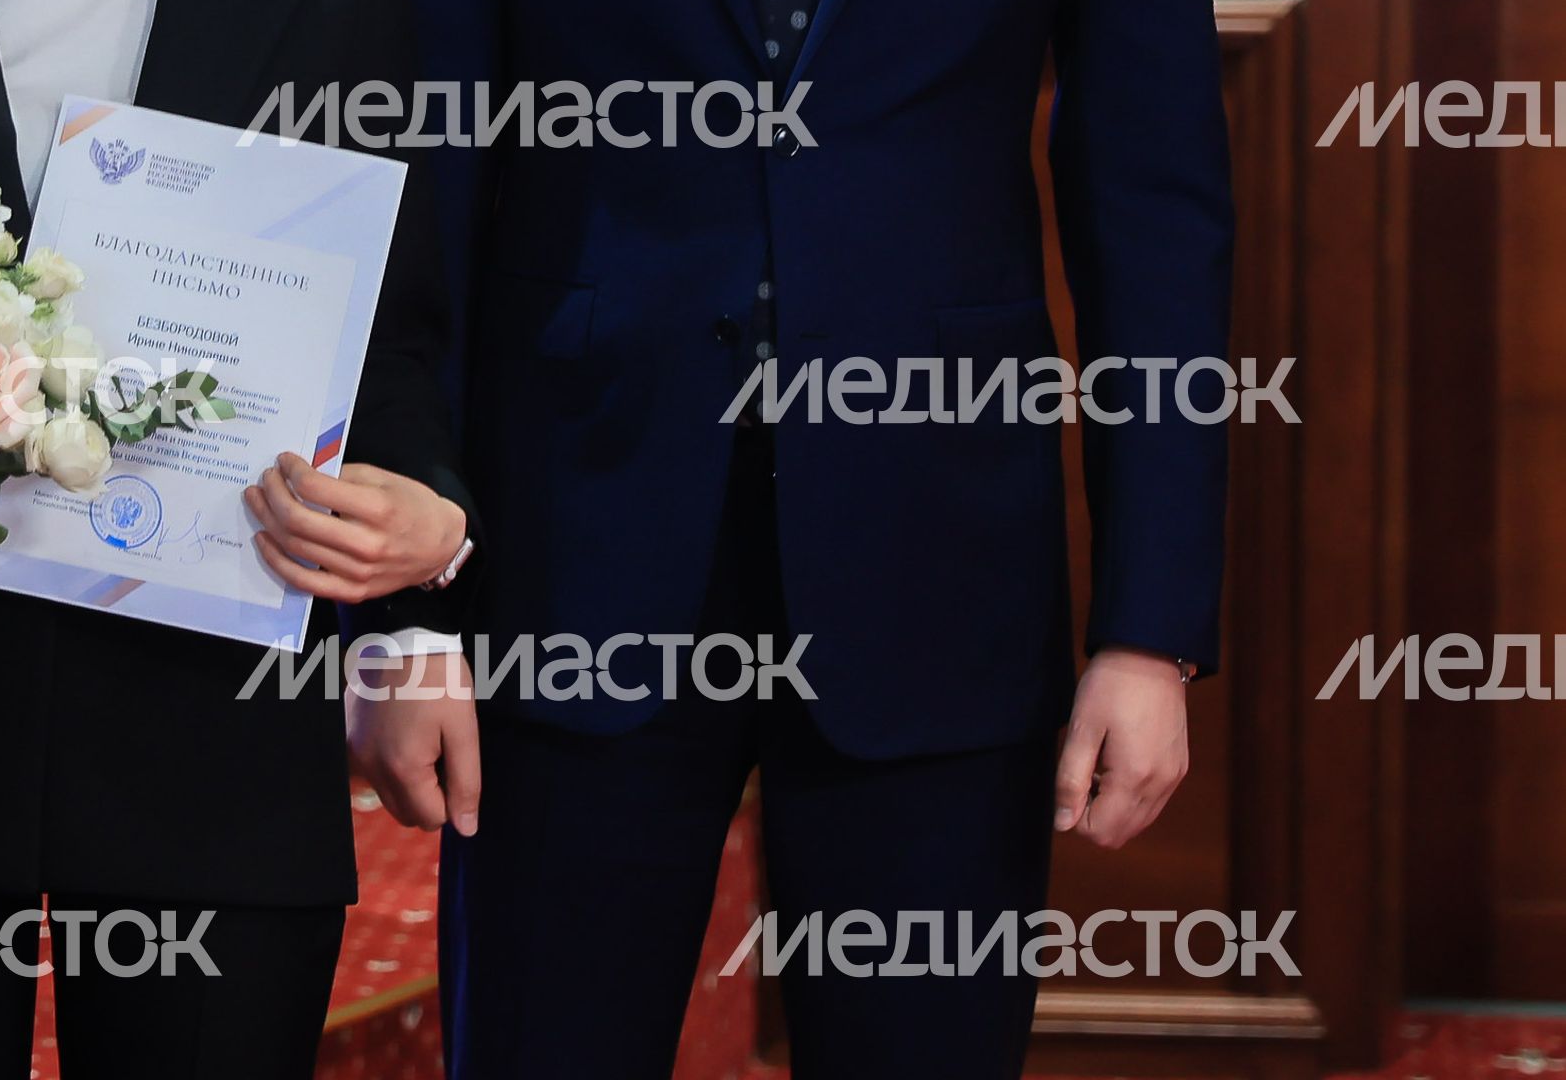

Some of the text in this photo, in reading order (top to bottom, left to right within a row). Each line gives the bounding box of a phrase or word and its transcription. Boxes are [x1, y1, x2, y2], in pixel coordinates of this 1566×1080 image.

[94, 232, 310, 291] БЛАГОДАРСТВЕННОЕ
[152, 269, 241, 300] ПИСЬМО
[137, 314, 239, 347] БЕЗБОРОДОВОЙ
[128, 331, 240, 367] Ирине Николаевне
